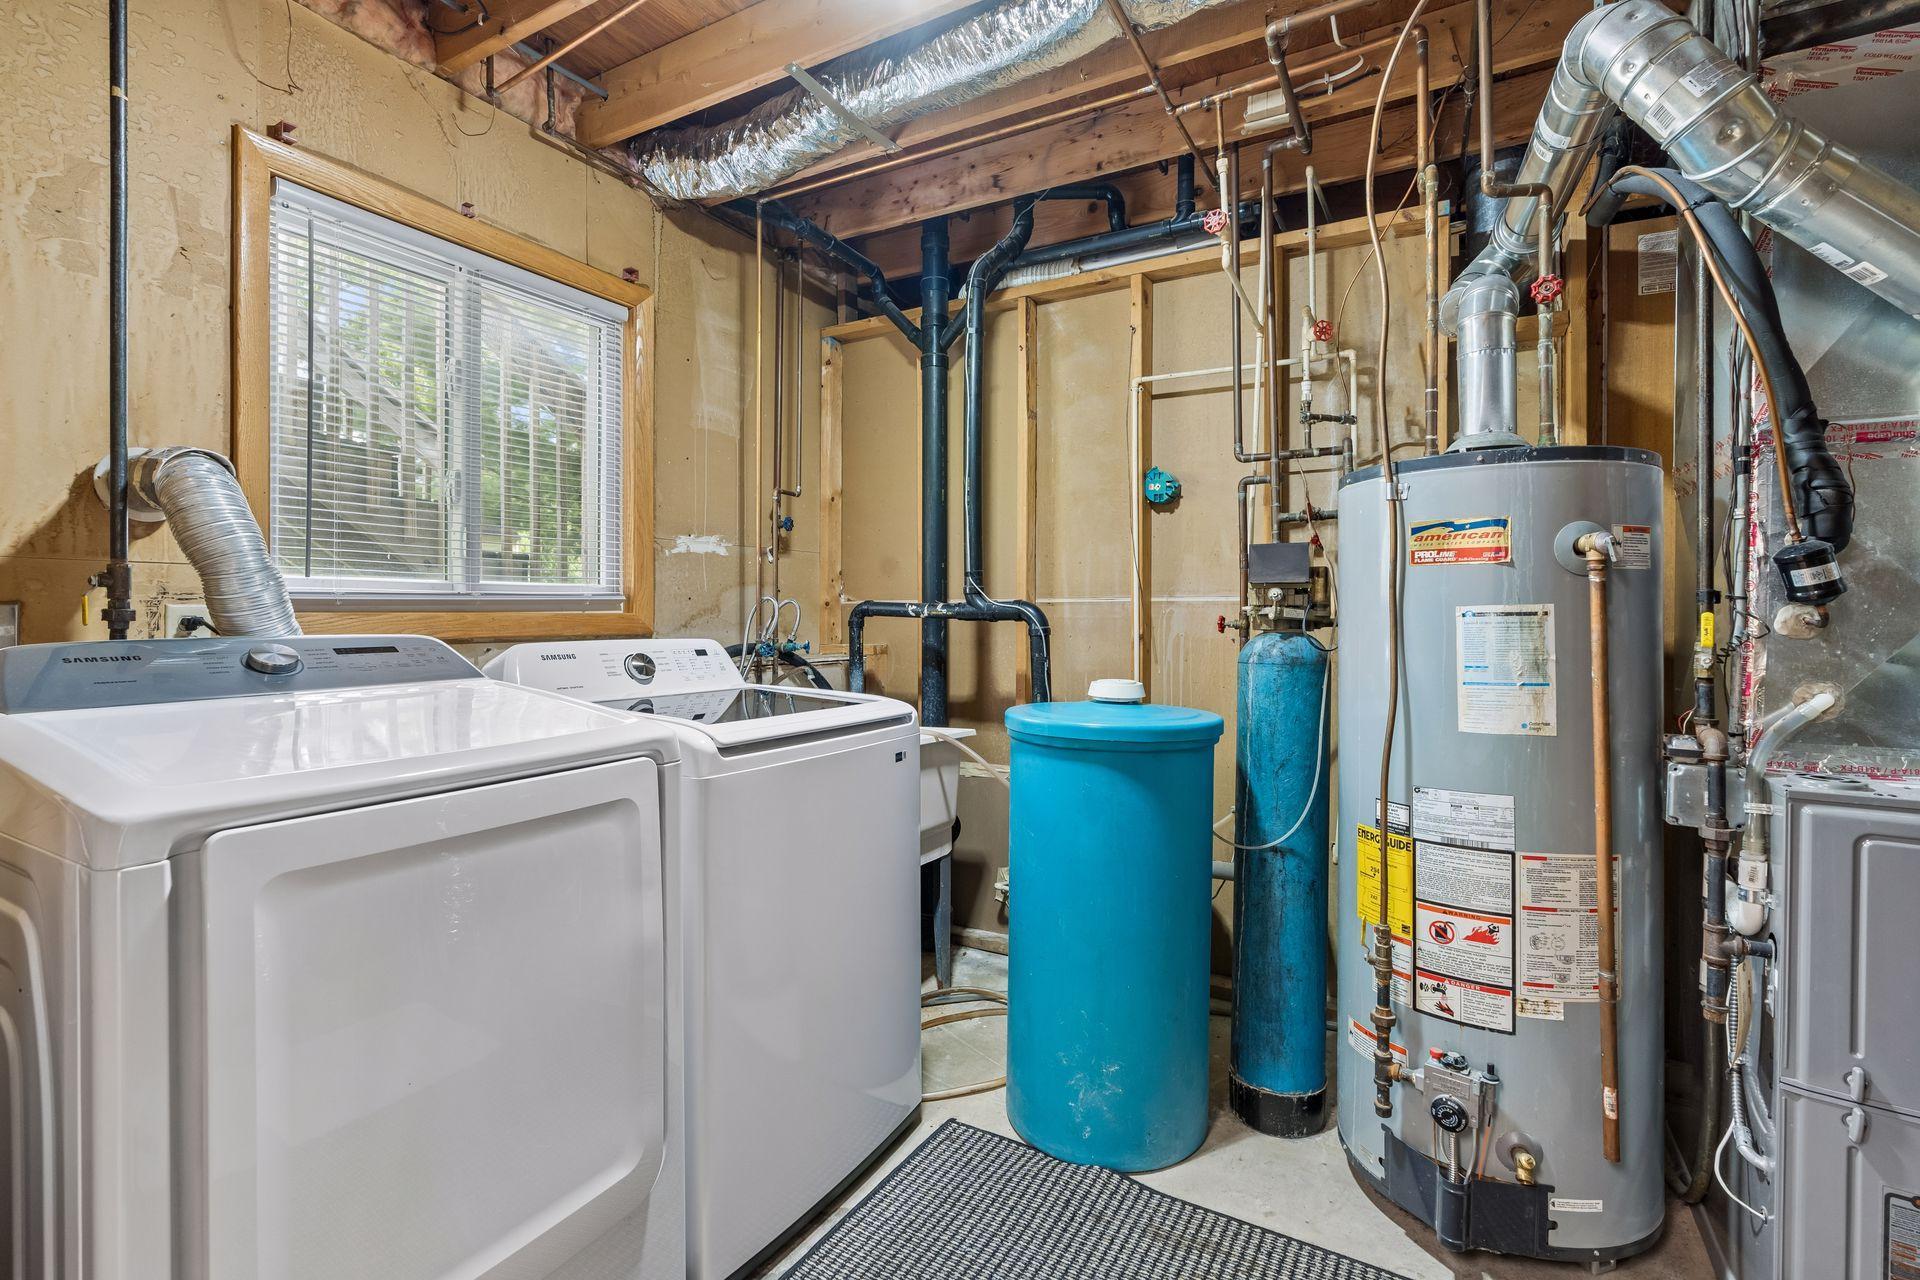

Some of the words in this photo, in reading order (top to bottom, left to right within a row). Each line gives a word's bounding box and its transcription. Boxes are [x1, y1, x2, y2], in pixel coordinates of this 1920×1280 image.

[1413, 531, 1504, 542] american
[1414, 550, 1456, 559] PROLINE
[62, 655, 142, 664] SAMSUNG
[540, 653, 577, 661] SAMSUNG
[1357, 827, 1412, 853] ENERGUIDE
[1448, 910, 1481, 920] WARNING
[1451, 980, 1482, 991] DANGER
